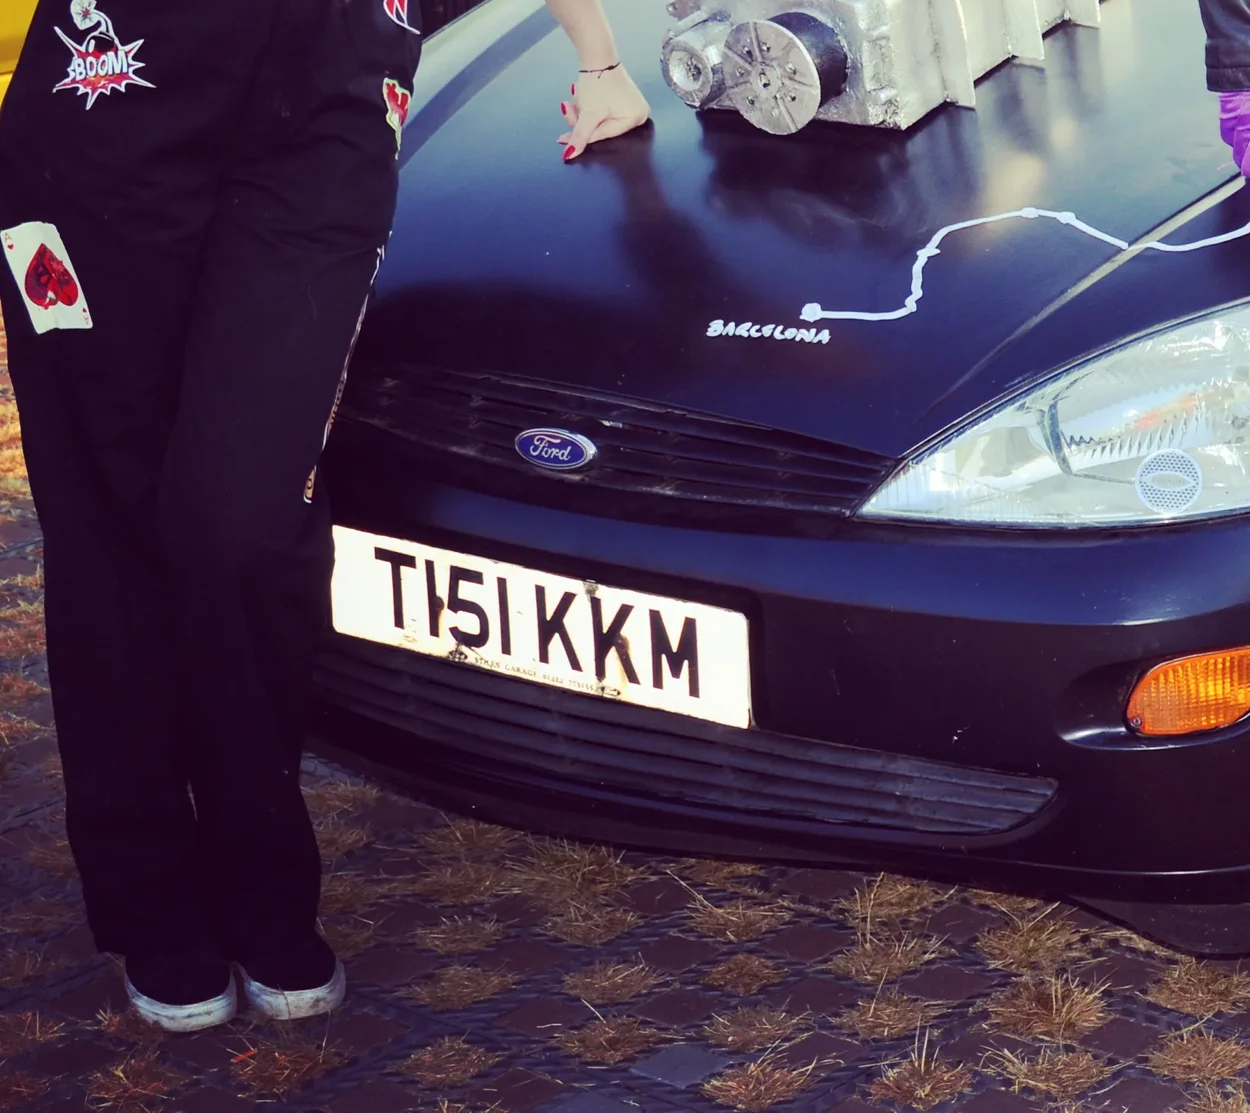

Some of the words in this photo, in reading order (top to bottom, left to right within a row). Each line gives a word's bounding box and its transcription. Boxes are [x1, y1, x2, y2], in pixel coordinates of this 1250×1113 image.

[74, 49, 129, 81] BOOM
[706, 319, 831, 344] BARCELONA
[530, 435, 571, 461] Ford
[535, 584, 700, 698] KKM
